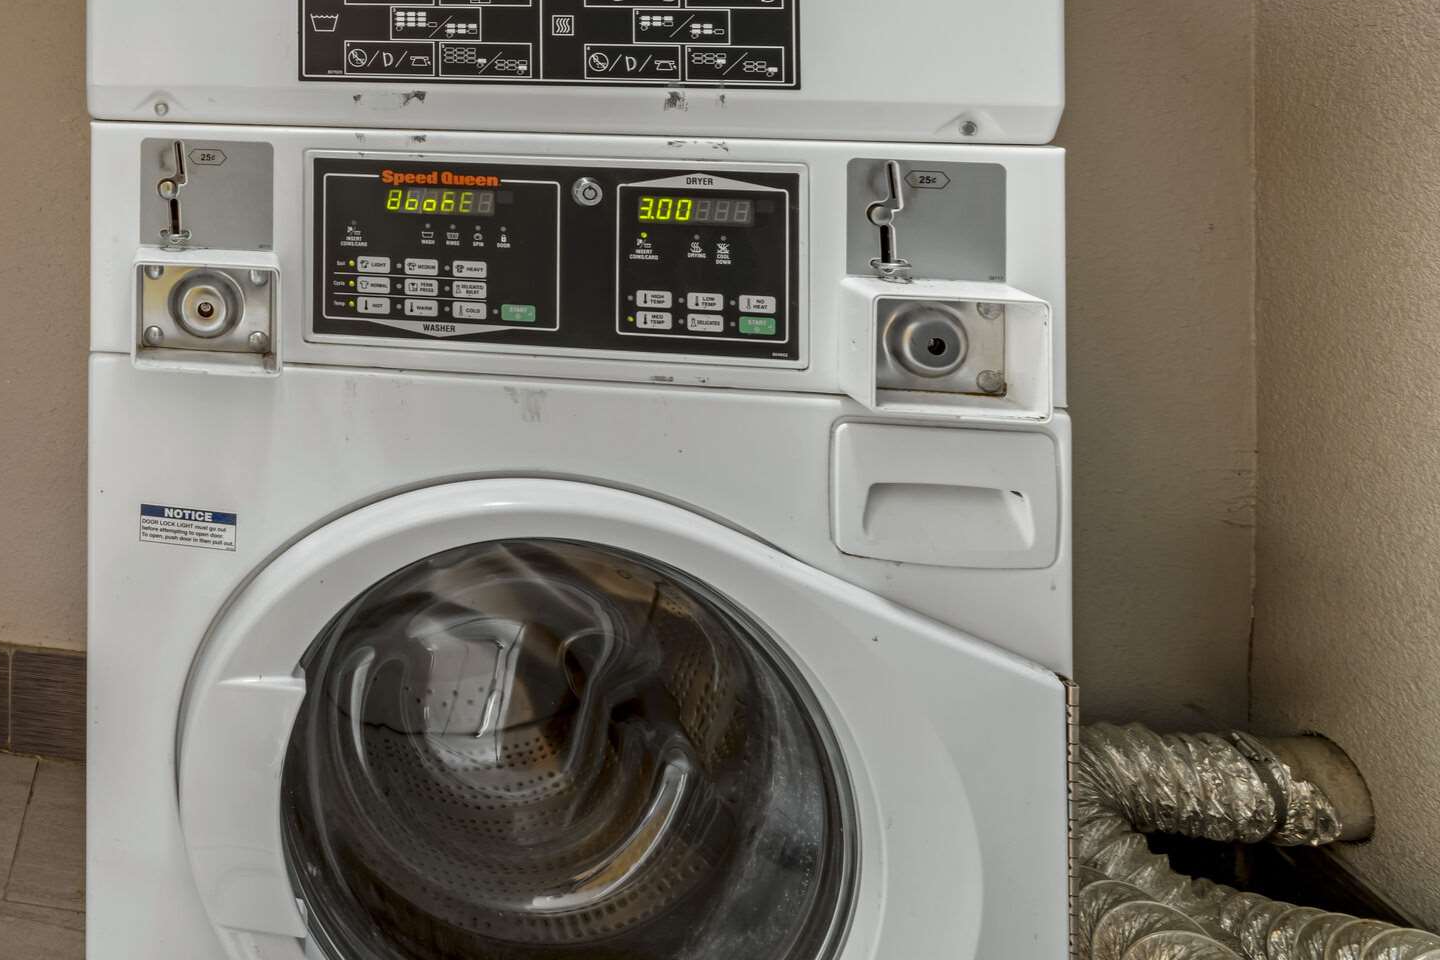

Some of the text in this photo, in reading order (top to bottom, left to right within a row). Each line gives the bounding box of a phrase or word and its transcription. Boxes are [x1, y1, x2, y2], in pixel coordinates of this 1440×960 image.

[382, 169, 499, 187] Speed Queen
[686, 177, 713, 185] DRYER
[639, 198, 692, 221] 3.00
[422, 323, 456, 333] WASHER
[164, 507, 213, 522] NOTICE
